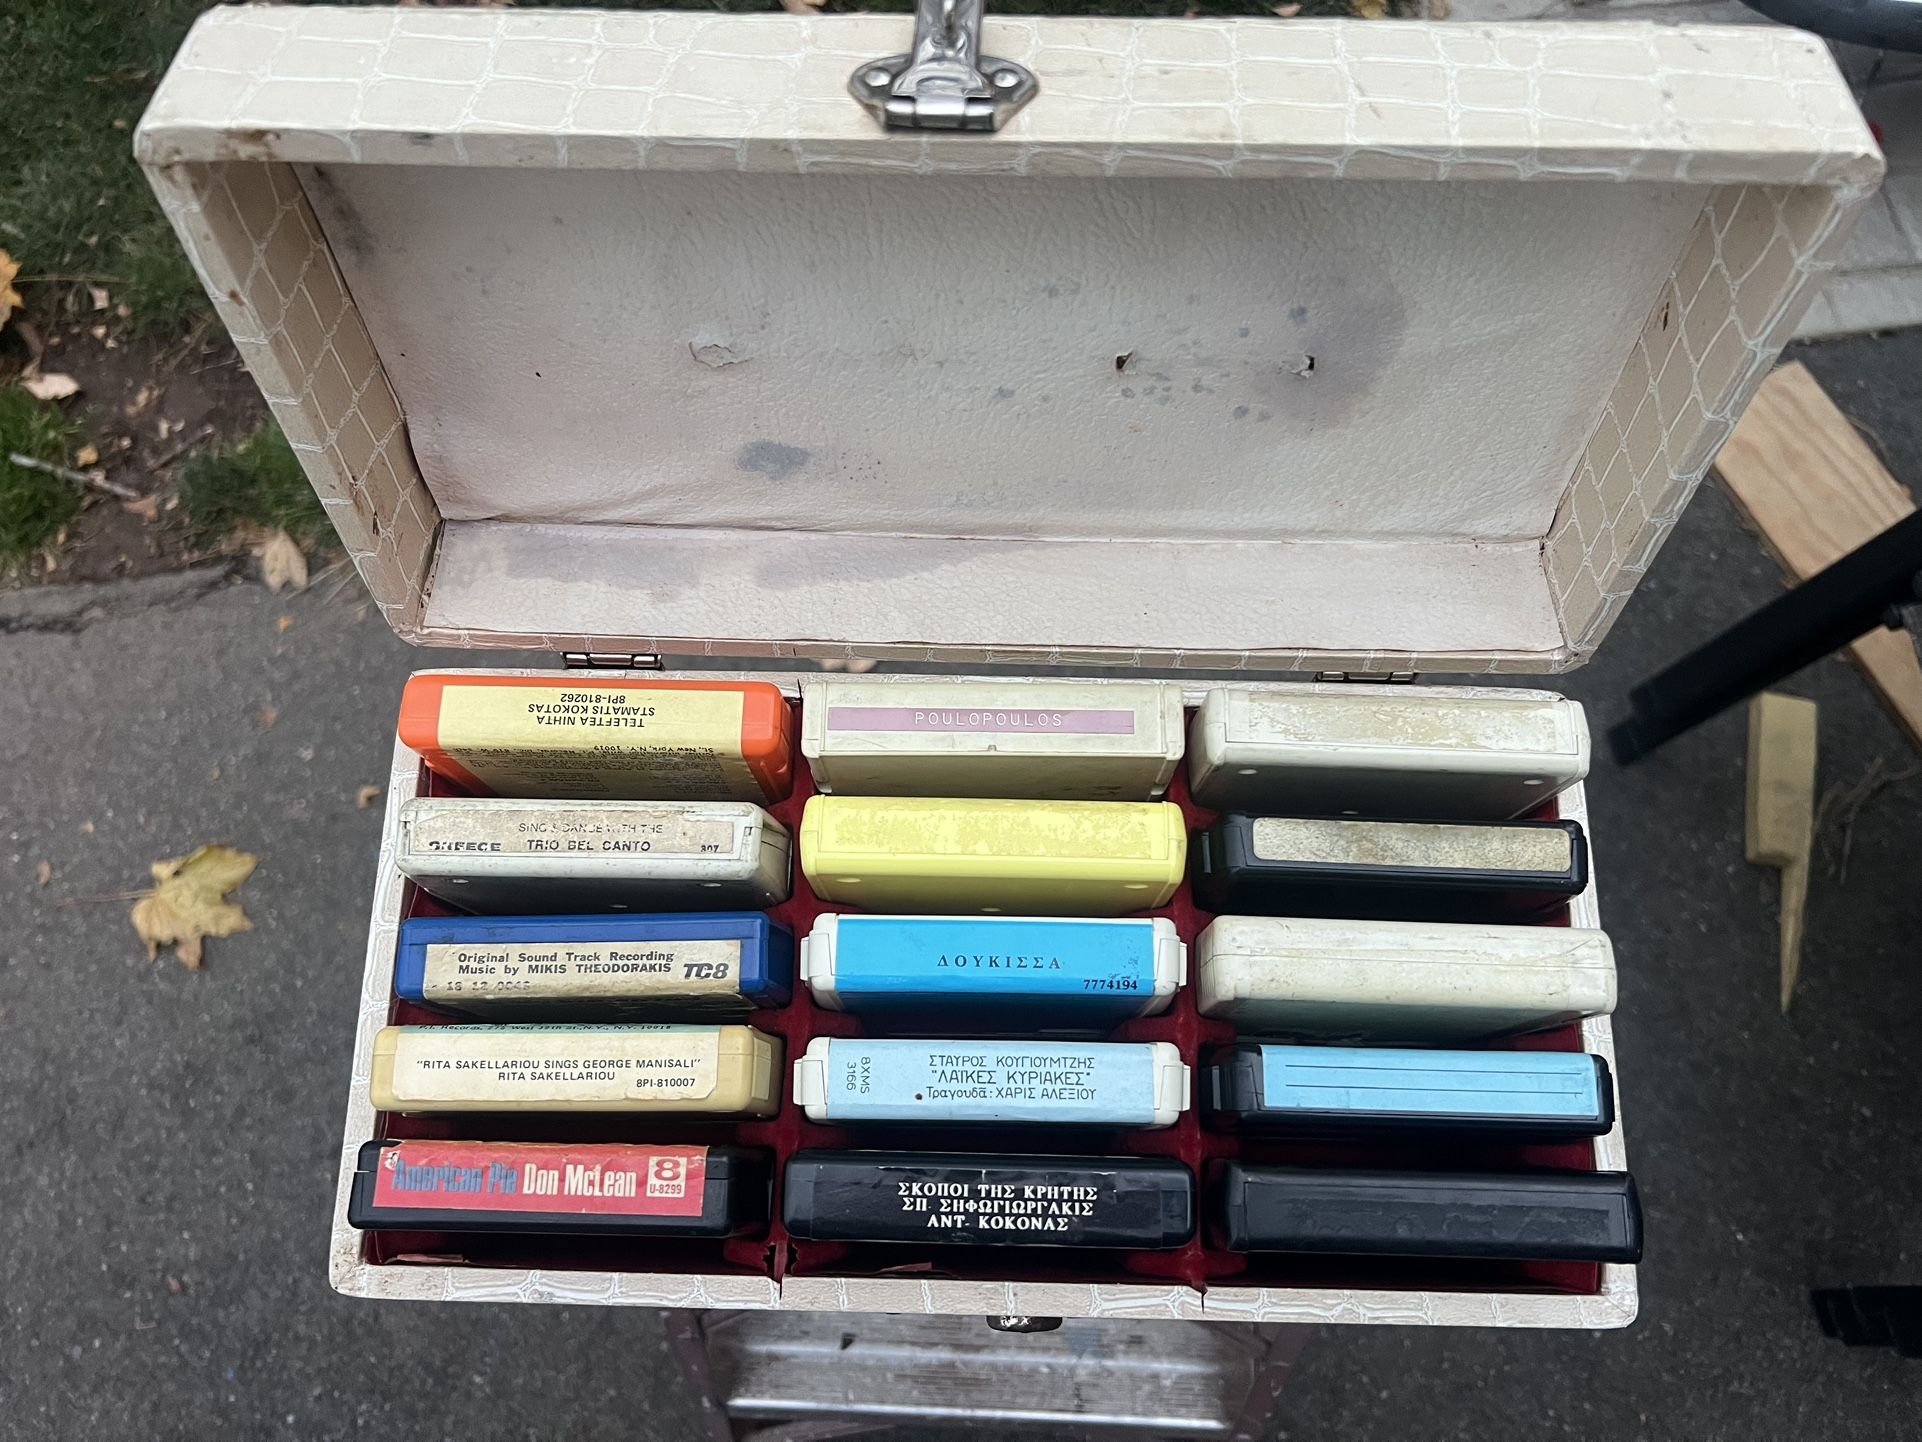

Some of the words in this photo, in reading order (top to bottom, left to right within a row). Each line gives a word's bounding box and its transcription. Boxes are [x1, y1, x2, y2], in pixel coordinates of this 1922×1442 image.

[561, 693, 626, 705] 8PI-810262
[528, 703, 589, 715] KOKOTAS
[592, 705, 655, 717] STAMATIS
[536, 715, 576, 726] NIHTA
[580, 715, 645, 728] TELEFTEA
[914, 711, 1064, 727] POULOPOULOS
[527, 839, 559, 851] TRIO
[568, 840, 594, 851] BEL
[602, 840, 651, 852] CANTO
[457, 952, 510, 964] Original
[518, 952, 557, 963] Sound
[565, 951, 601, 962] Track
[609, 951, 674, 963] Recording
[937, 954, 1061, 970] ΔΟΥΚΙΣΣΑ
[458, 963, 496, 975] Music
[504, 963, 519, 976] by
[527, 963, 567, 974] MIKIS
[576, 962, 672, 974] THEODORAKIS
[682, 962, 730, 980] TC8
[1083, 978, 1138, 992] 7774194
[455, 1060, 541, 1070] SAKELLARIOU
[543, 1059, 579, 1069] SINGS
[582, 1059, 632, 1069] GEORGE
[929, 1055, 987, 1067] ΣΤΑΥΡΟΣ
[996, 1056, 1096, 1069] ΚΟΥΓΙΟΥΜΤΖΗΣ
[498, 1071, 527, 1081] RITA
[530, 1071, 616, 1081] SAKELLARIOU
[846, 1062, 857, 1091] 3166
[859, 1056, 871, 1094] 8XMS
[636, 1078, 696, 1088] 8PI-810007
[996, 1087, 1036, 1099] ΧΑΡΙΣ
[1041, 1087, 1097, 1100] ΑΛΕΞΙΟΥ
[654, 1158, 682, 1182] 8
[392, 1159, 483, 1192] American
[487, 1161, 519, 1194] Pie
[522, 1163, 559, 1196] Don
[563, 1163, 636, 1197] McLean
[649, 1182, 683, 1196] U-8299
[898, 1182, 969, 1197] ΣΚΟΠΟΙ
[977, 1184, 1015, 1198] ΤΗΣ
[1024, 1185, 1098, 1201] ΚΡΗΤΗΣ
[939, 1198, 1094, 1216] ΣΗΦΩΓΙΩΡΓΑΚΙΣ
[978, 1215, 1069, 1231] ΚΟΚΟΝΑΣ
